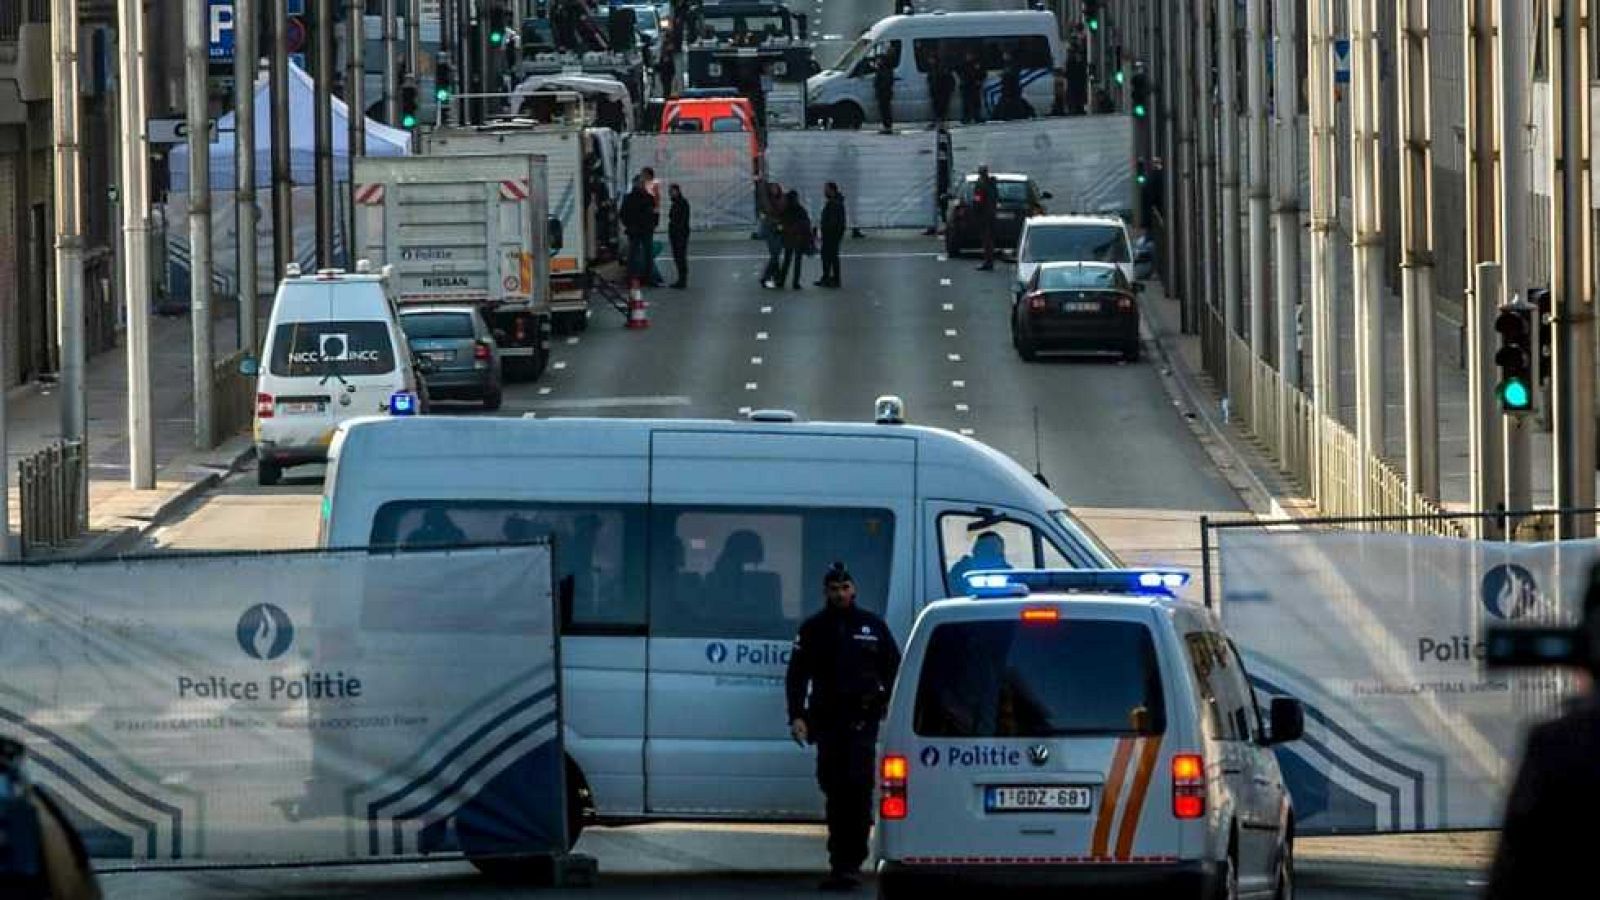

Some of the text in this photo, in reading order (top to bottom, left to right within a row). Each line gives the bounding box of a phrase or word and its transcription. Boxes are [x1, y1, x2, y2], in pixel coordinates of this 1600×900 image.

[422, 278, 469, 288] NISSAN
[288, 352, 318, 362] NICC
[736, 643, 792, 665] Polic
[1418, 635, 1488, 662] Polic
[178, 671, 362, 700] Police Politie
[949, 745, 1020, 766] Politie
